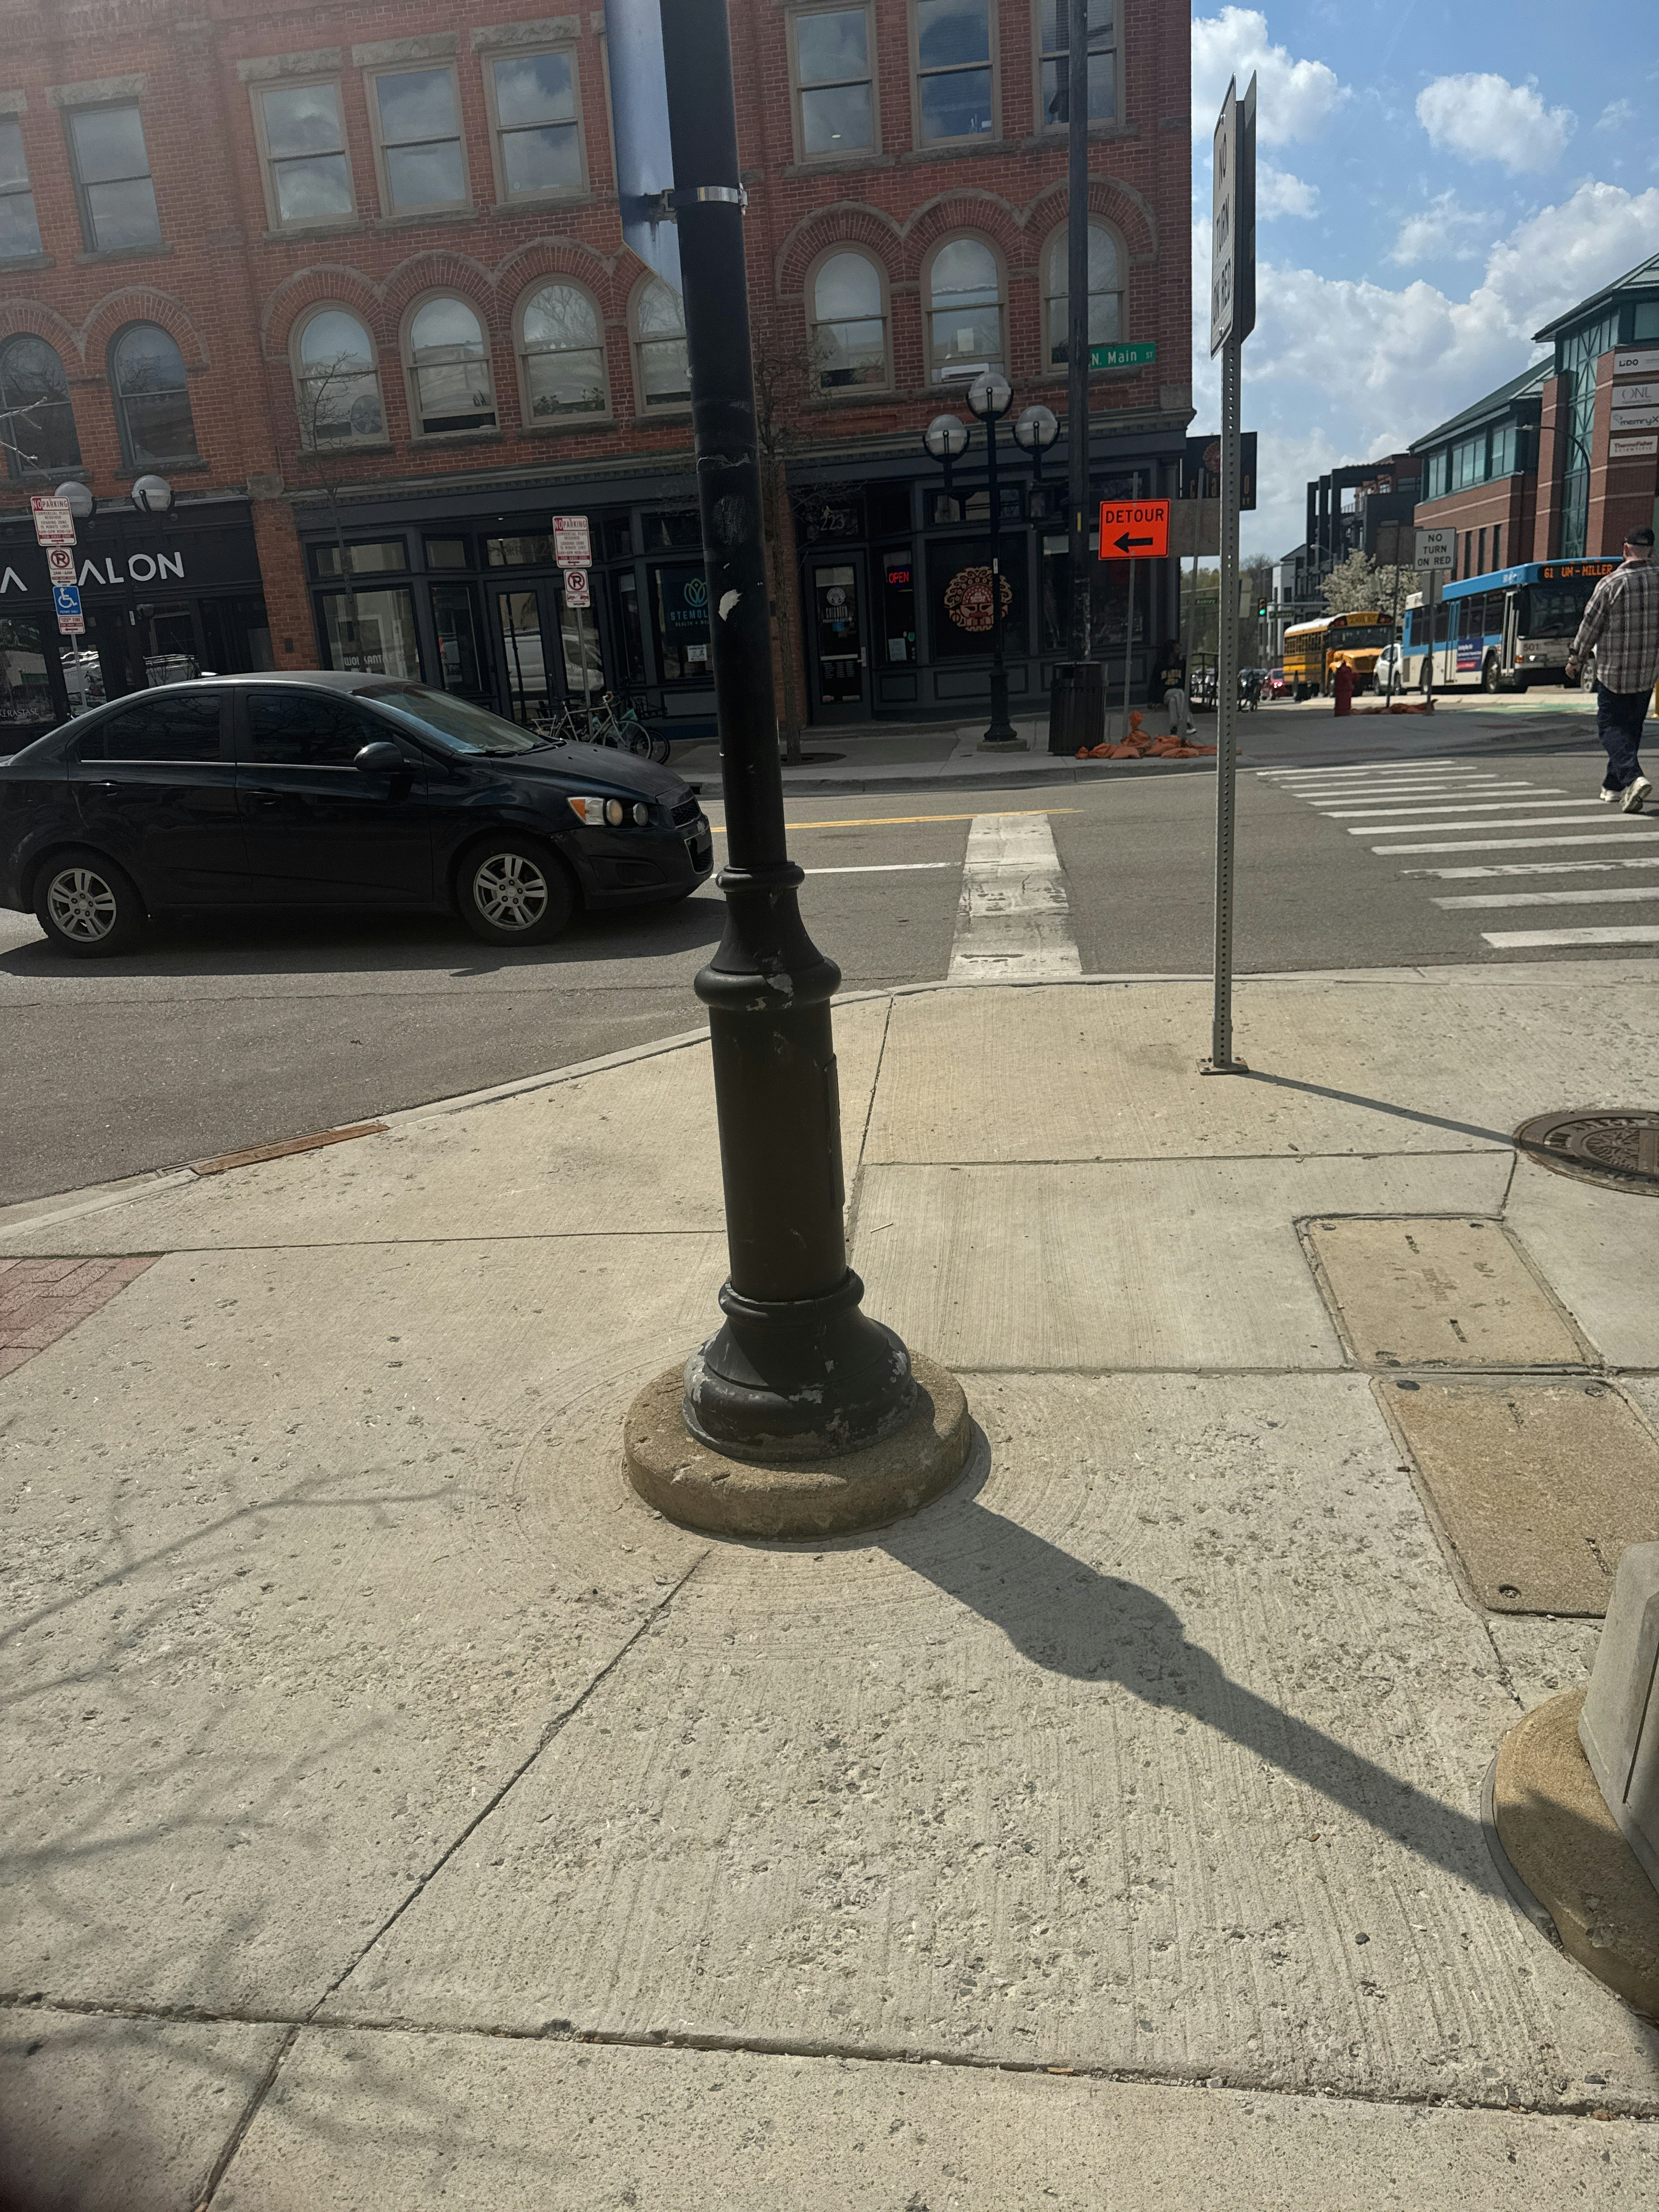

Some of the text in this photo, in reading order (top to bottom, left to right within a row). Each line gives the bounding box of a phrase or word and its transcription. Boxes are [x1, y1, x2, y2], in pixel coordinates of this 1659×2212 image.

[1218, 132, 1227, 189] NO
[1216, 193, 1229, 258] TURN
[1221, 258, 1231, 313] RED
[1092, 353, 1102, 366] N.
[1108, 350, 1137, 364] Main
[1622, 386, 1651, 400] ONL
[32, 500, 67, 509] NO PARKING
[820, 514, 845, 531] 223
[1105, 508, 1164, 524] DETOUR
[554, 520, 563, 529] NO
[1427, 533, 1443, 543] NO
[1423, 545, 1447, 554] TURN
[1417, 556, 1451, 566] ON RED
[889, 571, 909, 584] OPEN
[1544, 567, 1554, 578] 61
[1561, 566, 1573, 578] UM
[1582, 564, 1613, 576] MILLER
[670, 610, 708, 621] STEMOL
